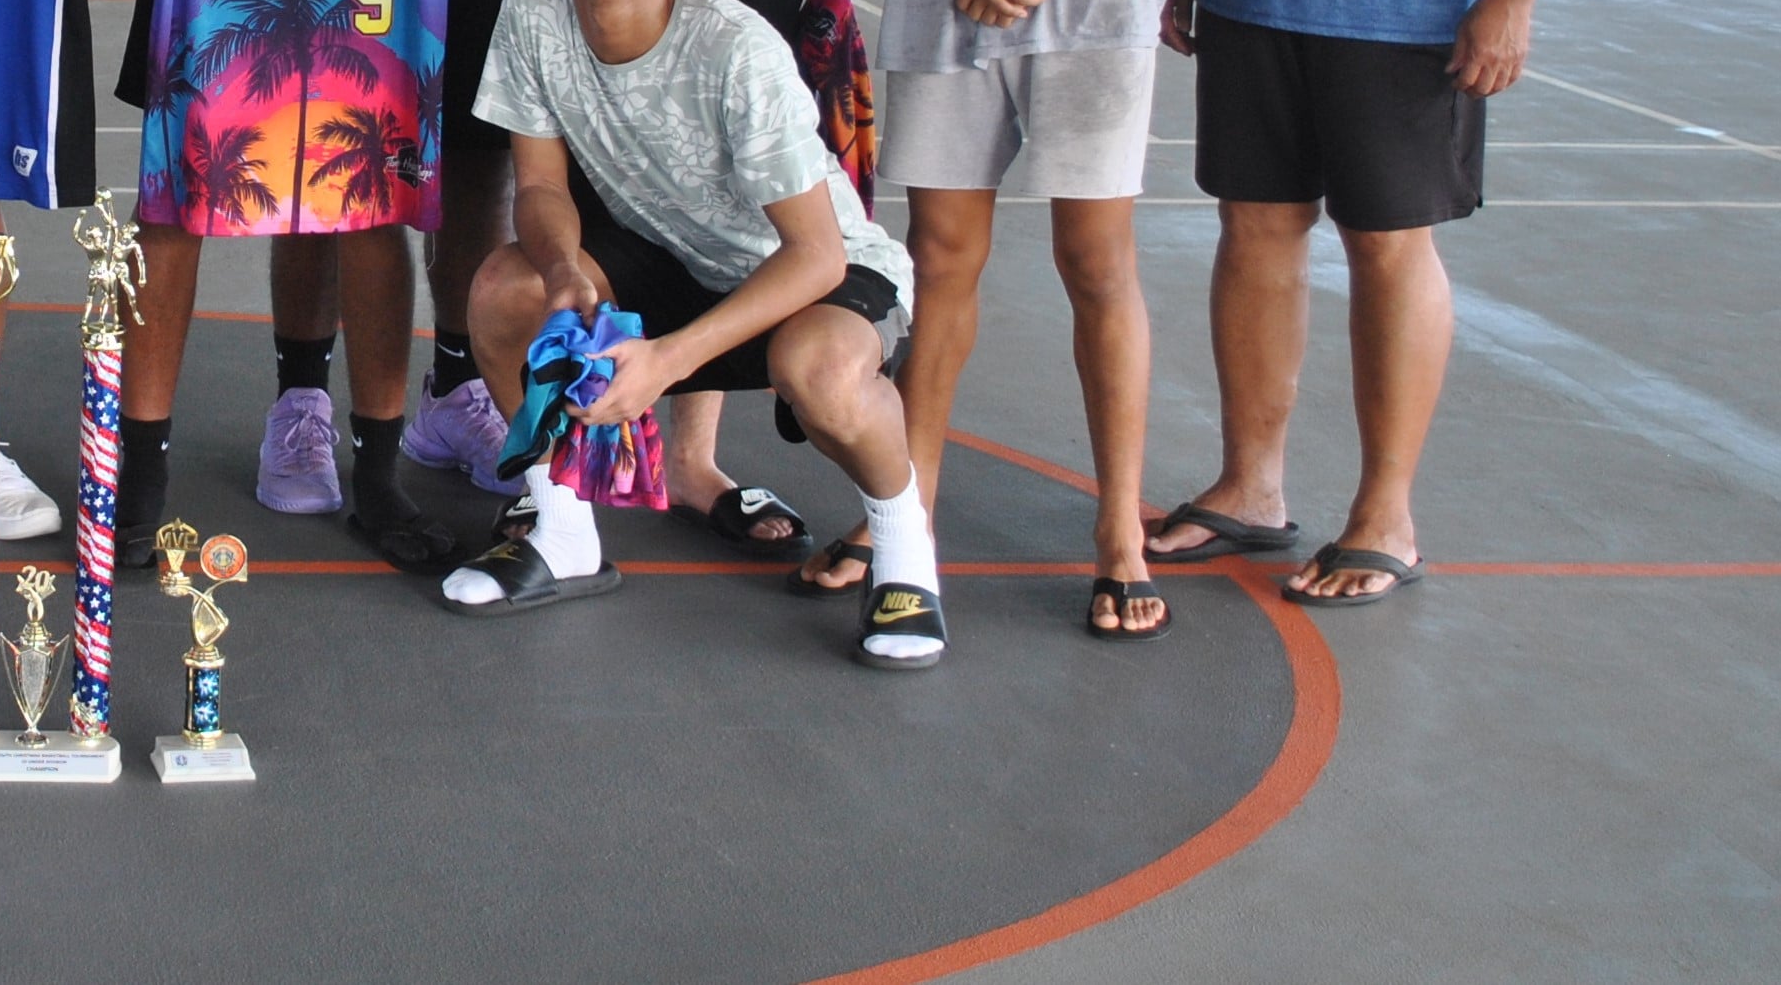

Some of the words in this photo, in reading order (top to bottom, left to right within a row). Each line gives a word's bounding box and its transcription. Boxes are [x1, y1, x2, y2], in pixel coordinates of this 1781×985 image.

[156, 531, 198, 549] MVP
[21, 565, 51, 593] 20
[882, 591, 922, 610] NIKE
